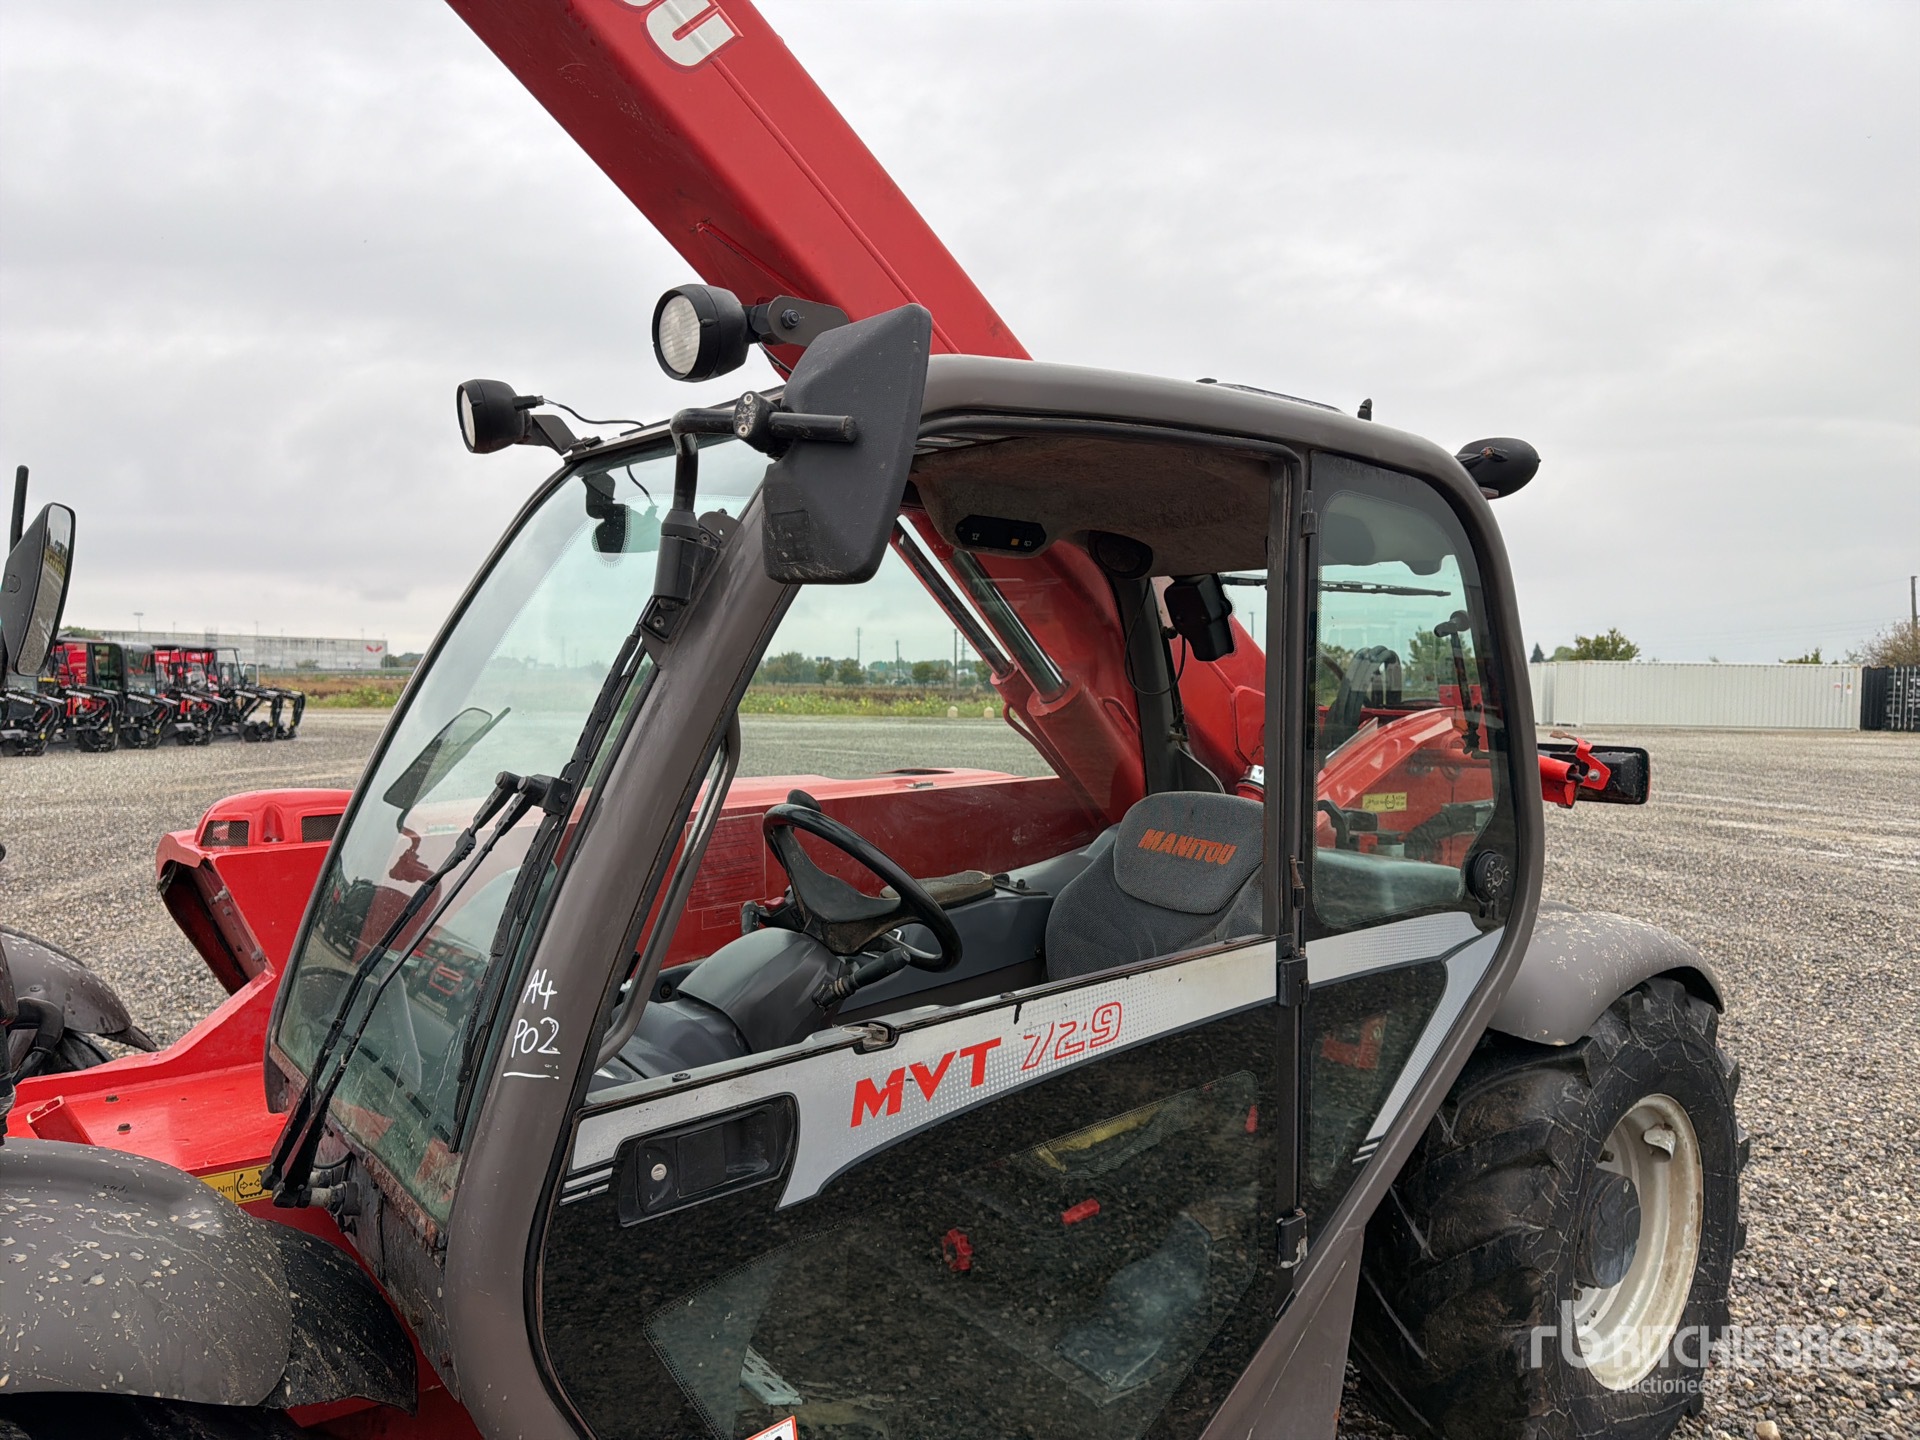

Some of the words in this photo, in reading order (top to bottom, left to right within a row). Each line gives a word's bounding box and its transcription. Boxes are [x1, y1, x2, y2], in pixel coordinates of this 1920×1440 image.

[1138, 829, 1237, 865] MANITOU
[522, 968, 558, 1011] A4
[851, 1037, 1002, 1128] MVT
[1021, 1001, 1123, 1071] 729
